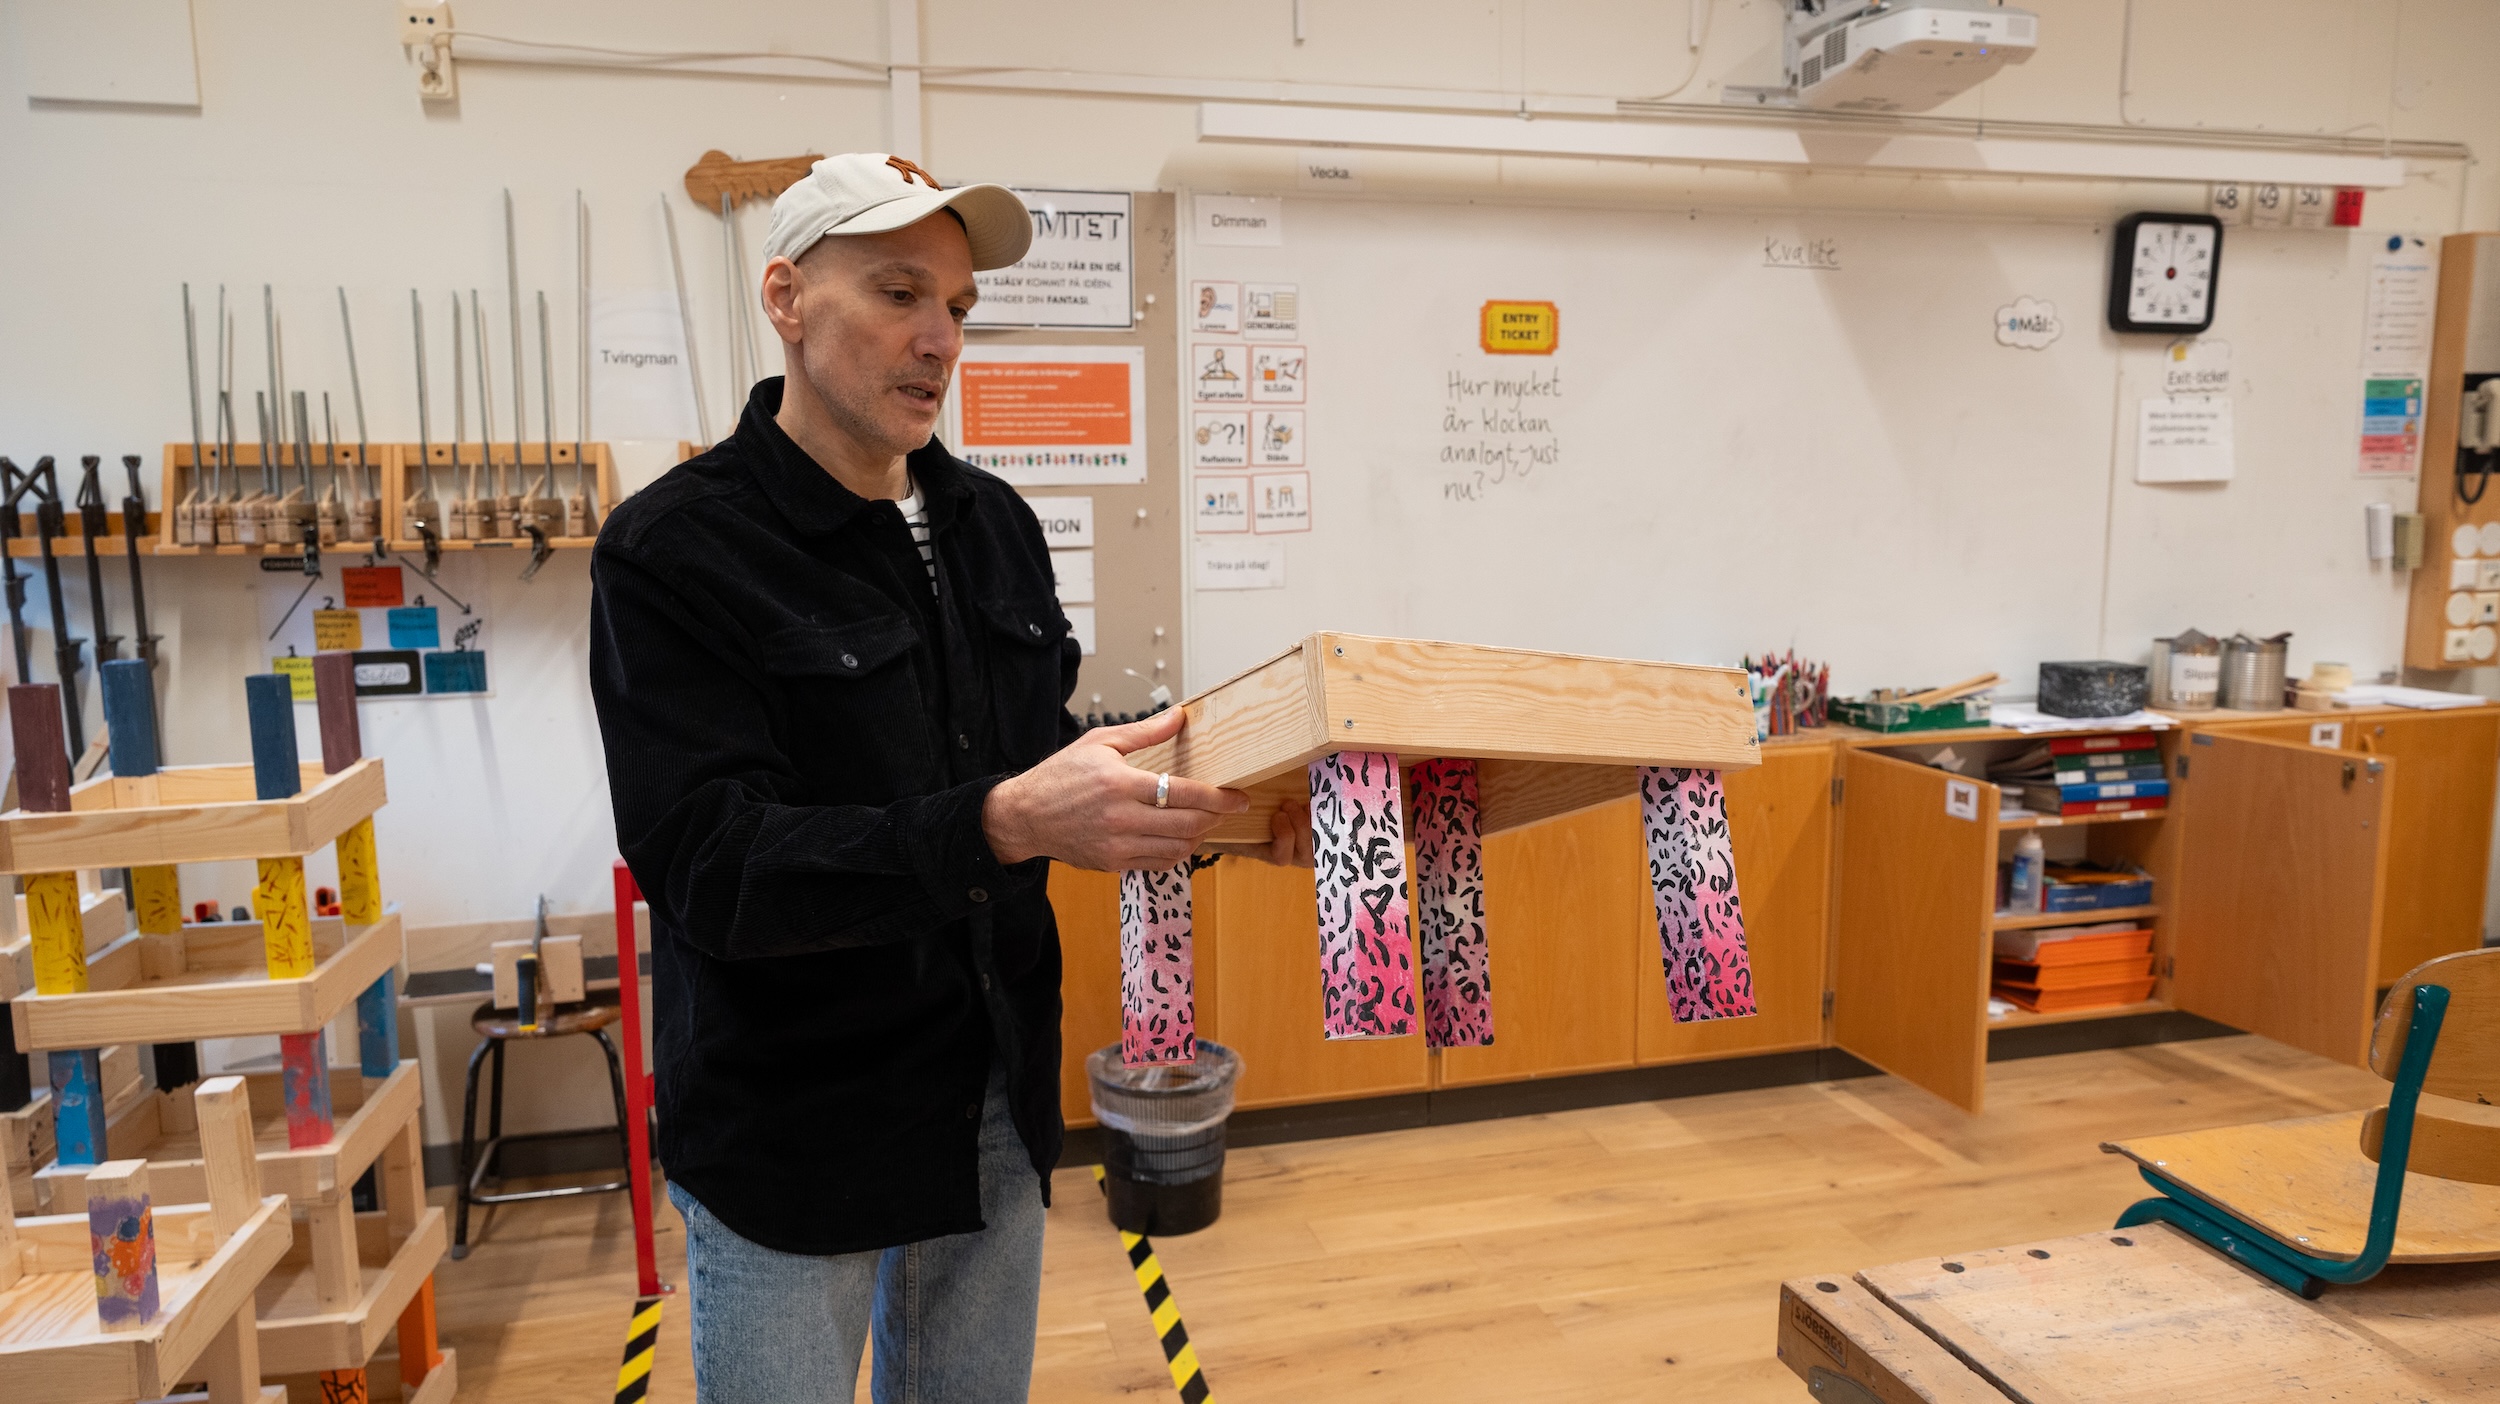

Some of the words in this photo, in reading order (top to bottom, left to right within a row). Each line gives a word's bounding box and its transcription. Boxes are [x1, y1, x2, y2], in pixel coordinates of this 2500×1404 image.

[2214, 187, 2239, 210] 48
[1211, 213, 1267, 229] Dimman
[1050, 261, 1066, 271] DU
[1090, 261, 1103, 272] EN
[1026, 295, 1045, 305] DIN
[1502, 312, 1540, 324] ENTRY
[1500, 329, 1541, 341] TICKET
[601, 349, 679, 369] Tvingman
[1447, 369, 1490, 404] Hur
[1493, 366, 1564, 413] mycket
[1442, 405, 1474, 434] är
[1481, 407, 1554, 434] klockan
[1443, 469, 1486, 501] nu?
[364, 553, 375, 568] 3
[323, 595, 335, 610] 2
[288, 645, 297, 658] 1
[1796, 1307, 1843, 1356] SJÖBERGS
